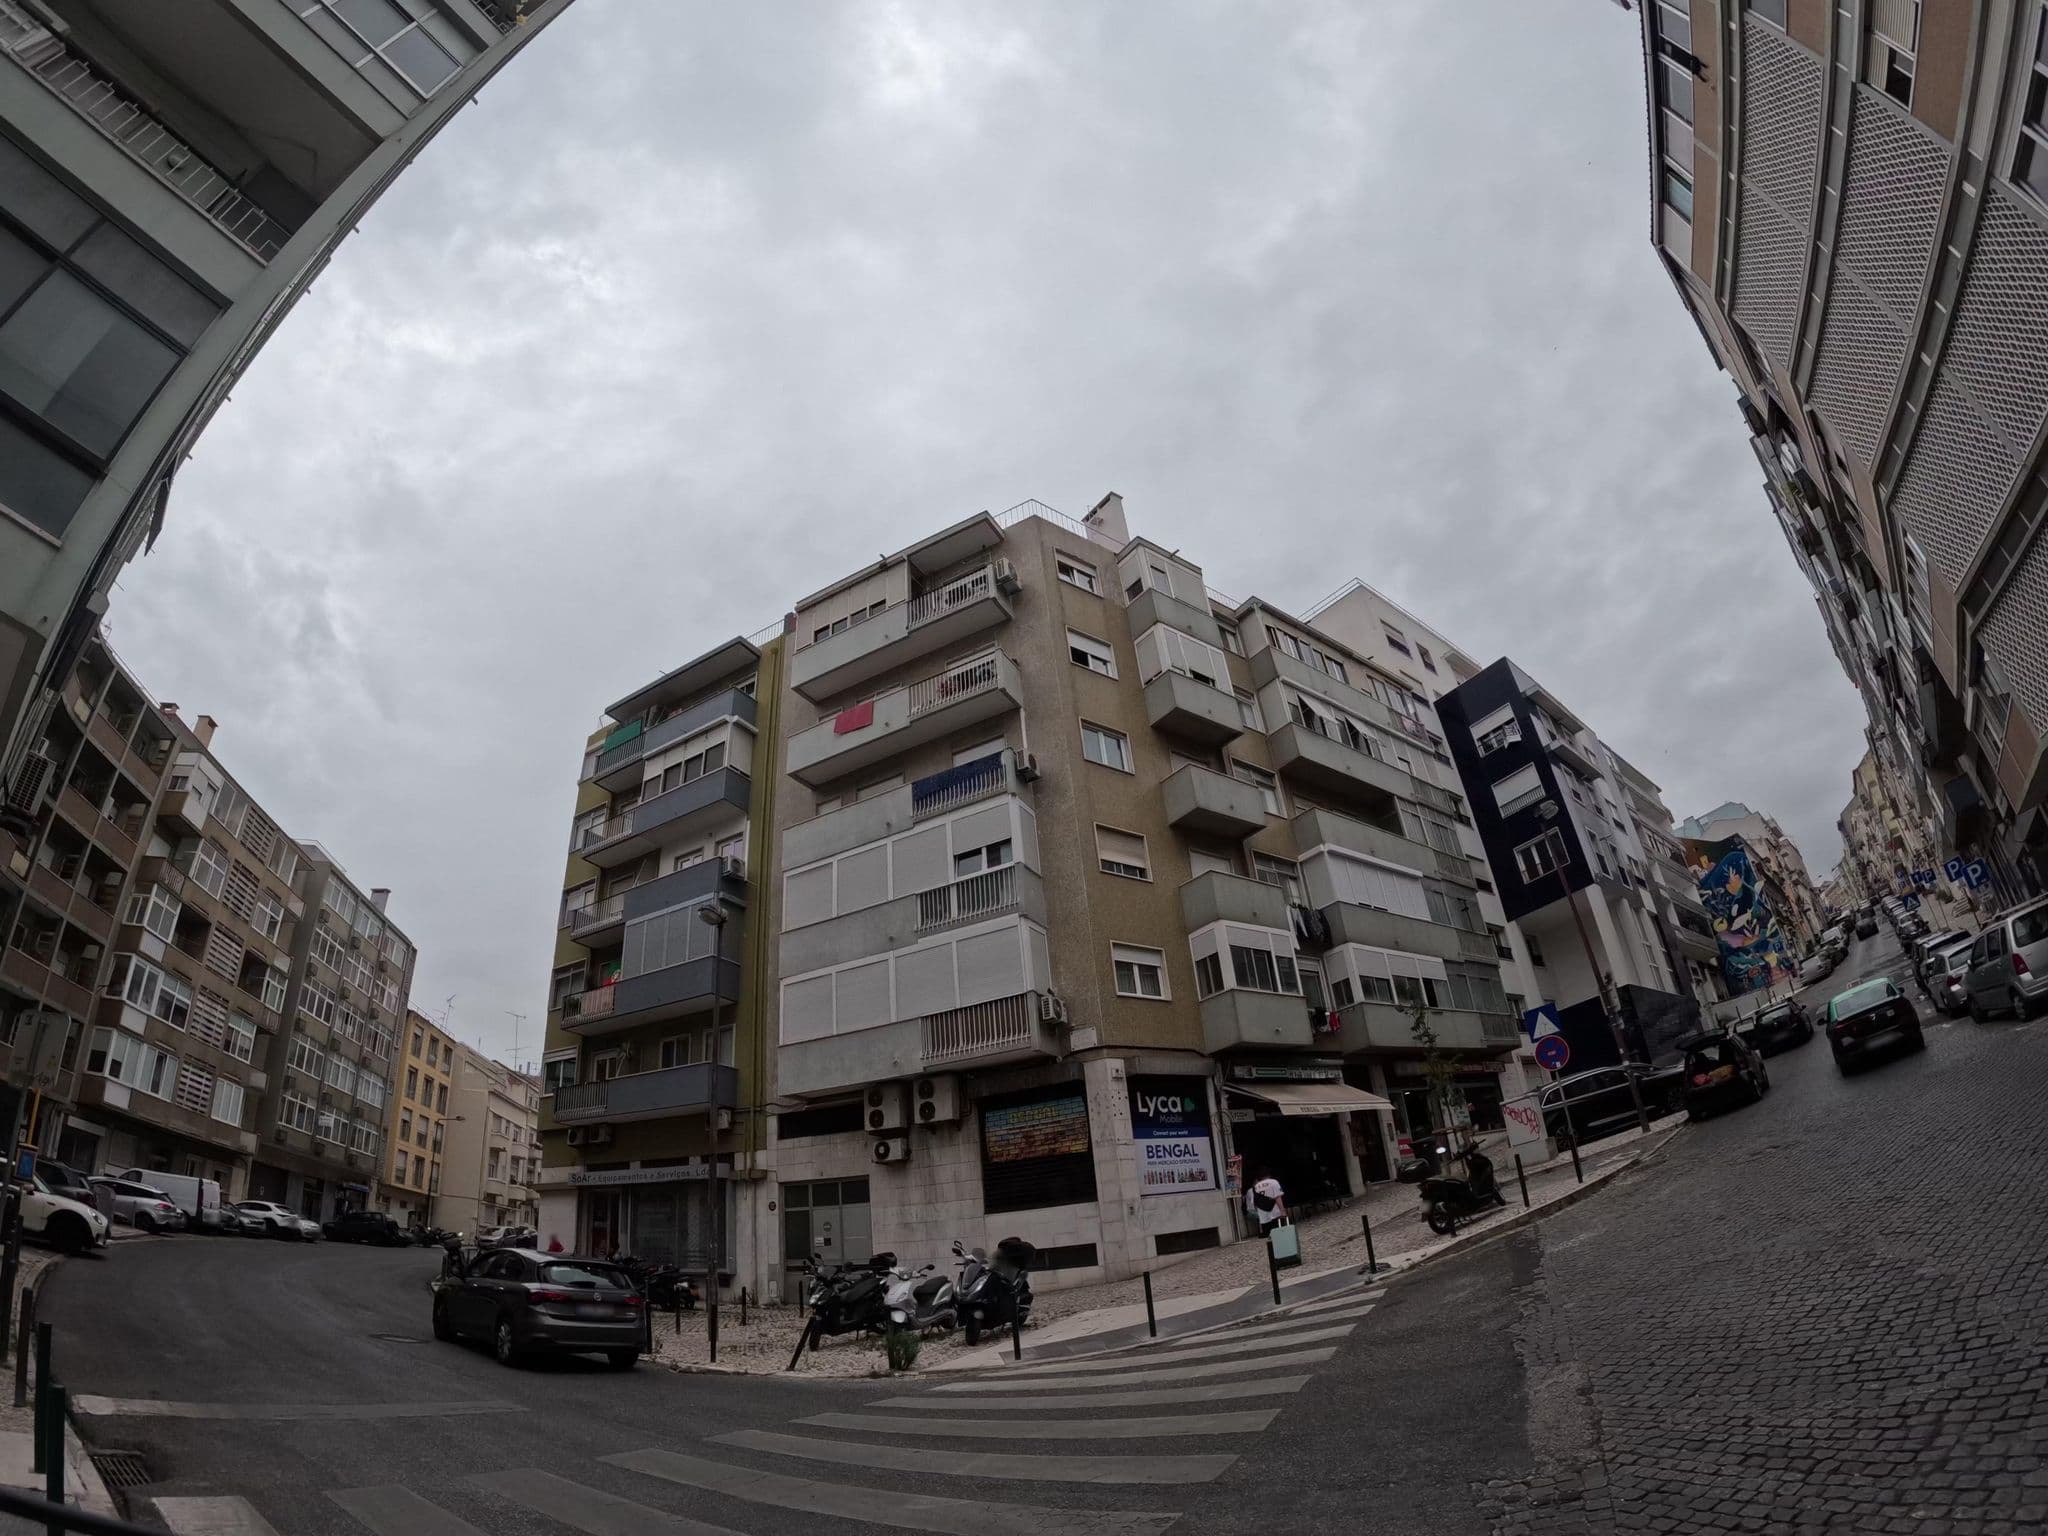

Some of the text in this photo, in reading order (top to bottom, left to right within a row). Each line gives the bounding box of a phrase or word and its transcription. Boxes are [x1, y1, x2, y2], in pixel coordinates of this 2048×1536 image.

[1947, 861, 1960, 879] P
[1967, 863, 1982, 886] P
[1136, 1090, 1183, 1118] Lyca
[1145, 1143, 1199, 1159] BENGAL
